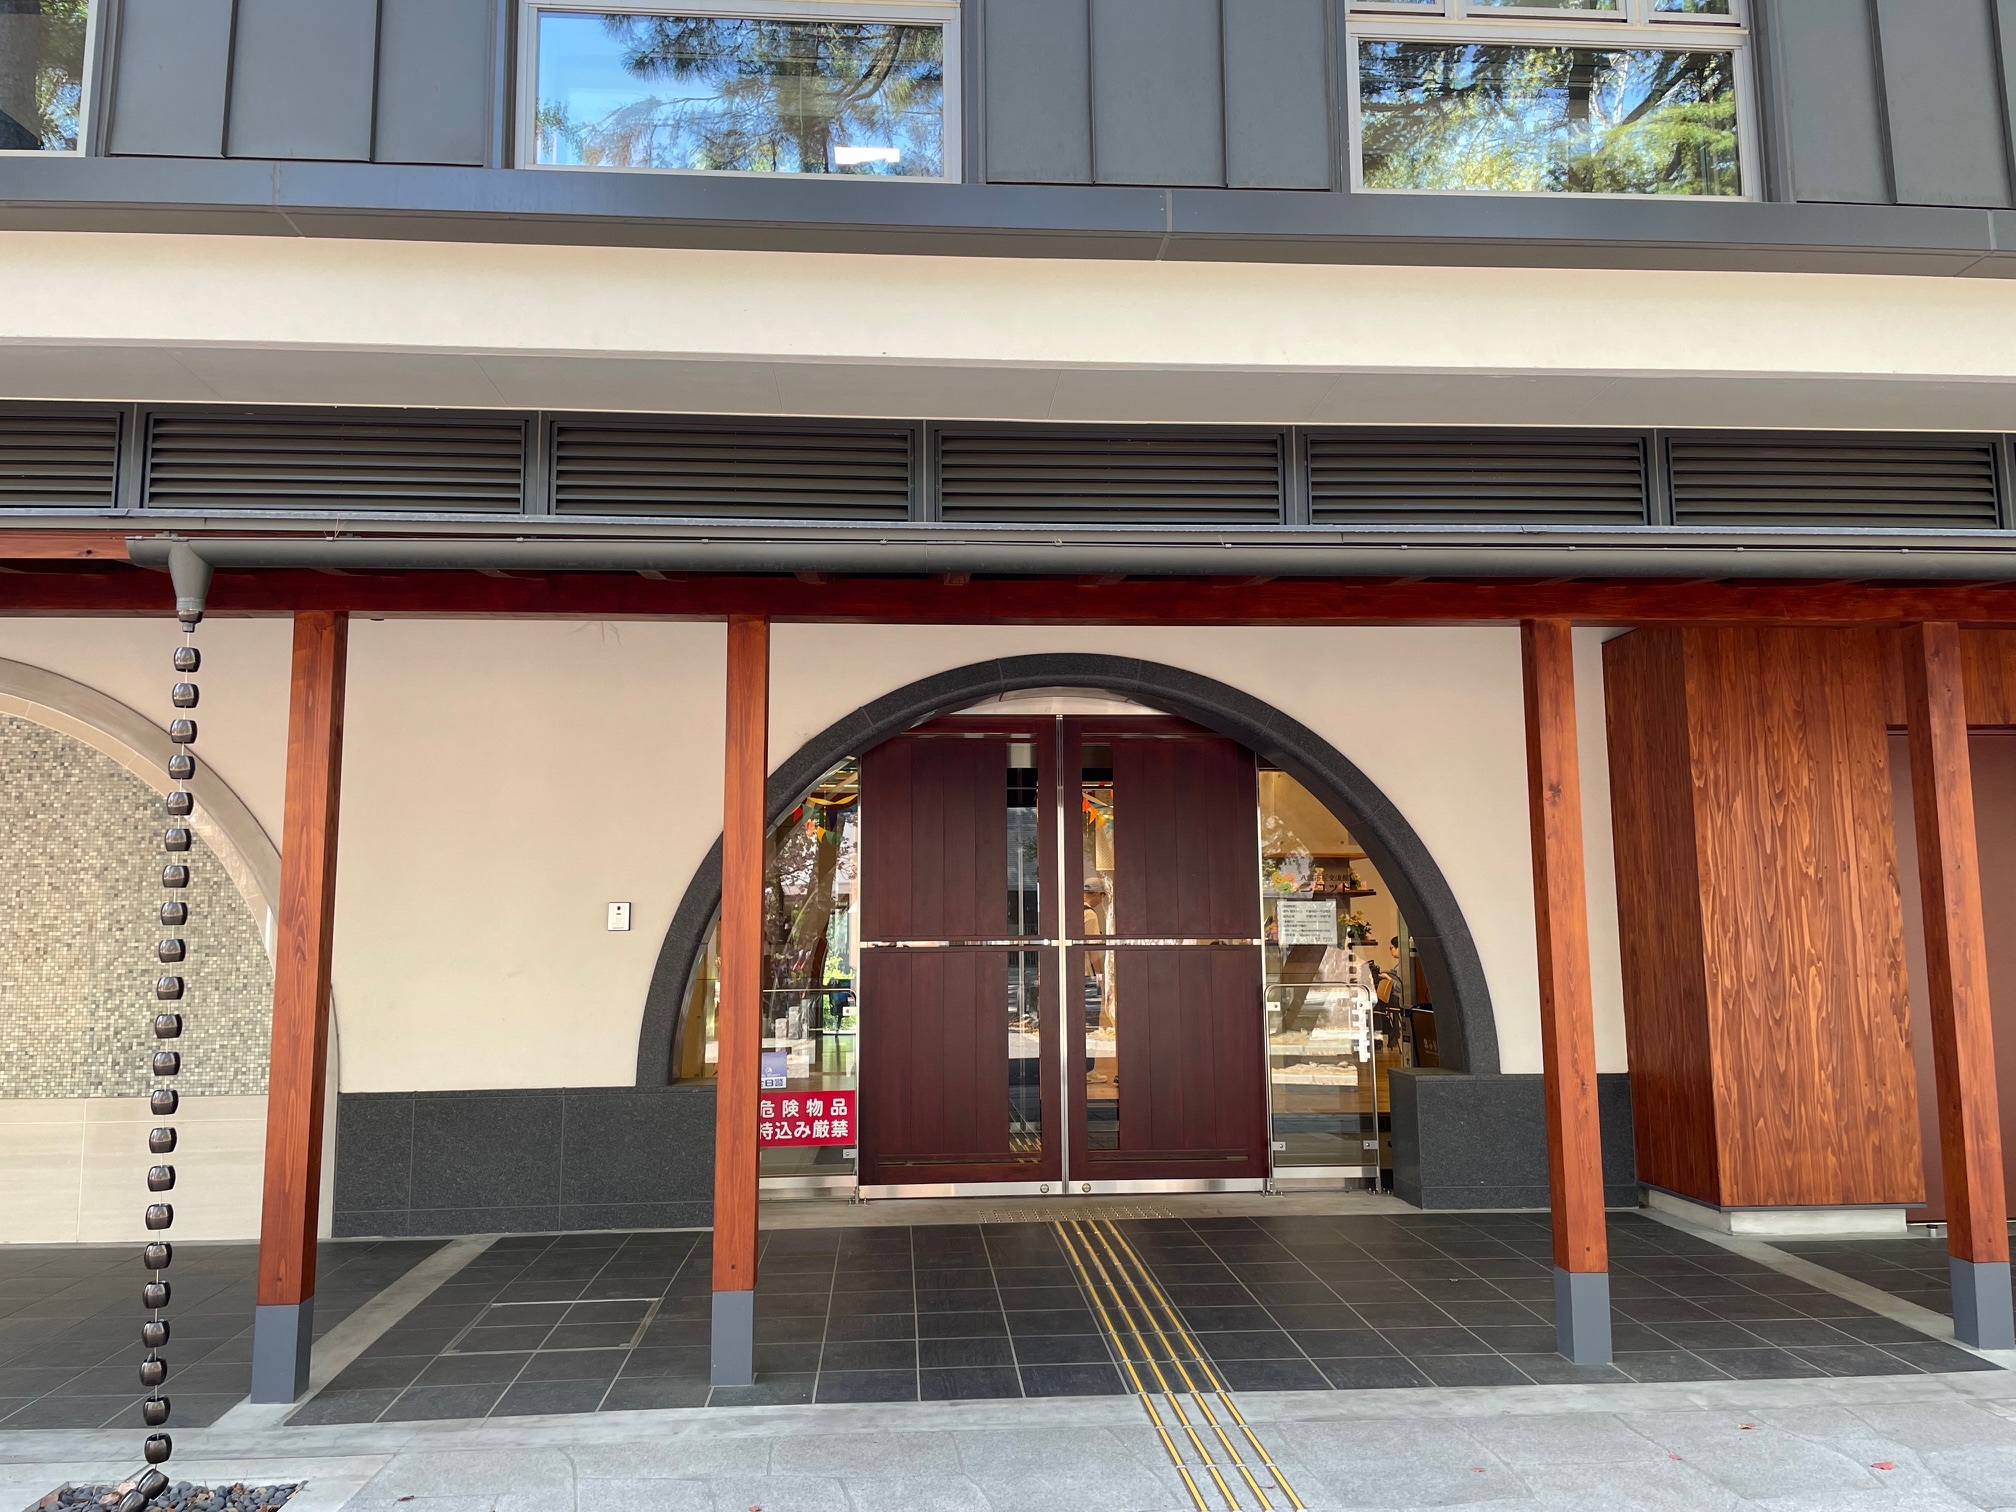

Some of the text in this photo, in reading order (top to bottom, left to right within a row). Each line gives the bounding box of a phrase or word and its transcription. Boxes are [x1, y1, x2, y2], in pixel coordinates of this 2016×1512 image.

[760, 1098, 848, 1118] 危険物品
[760, 1118, 849, 1141] 持込み厳禁
